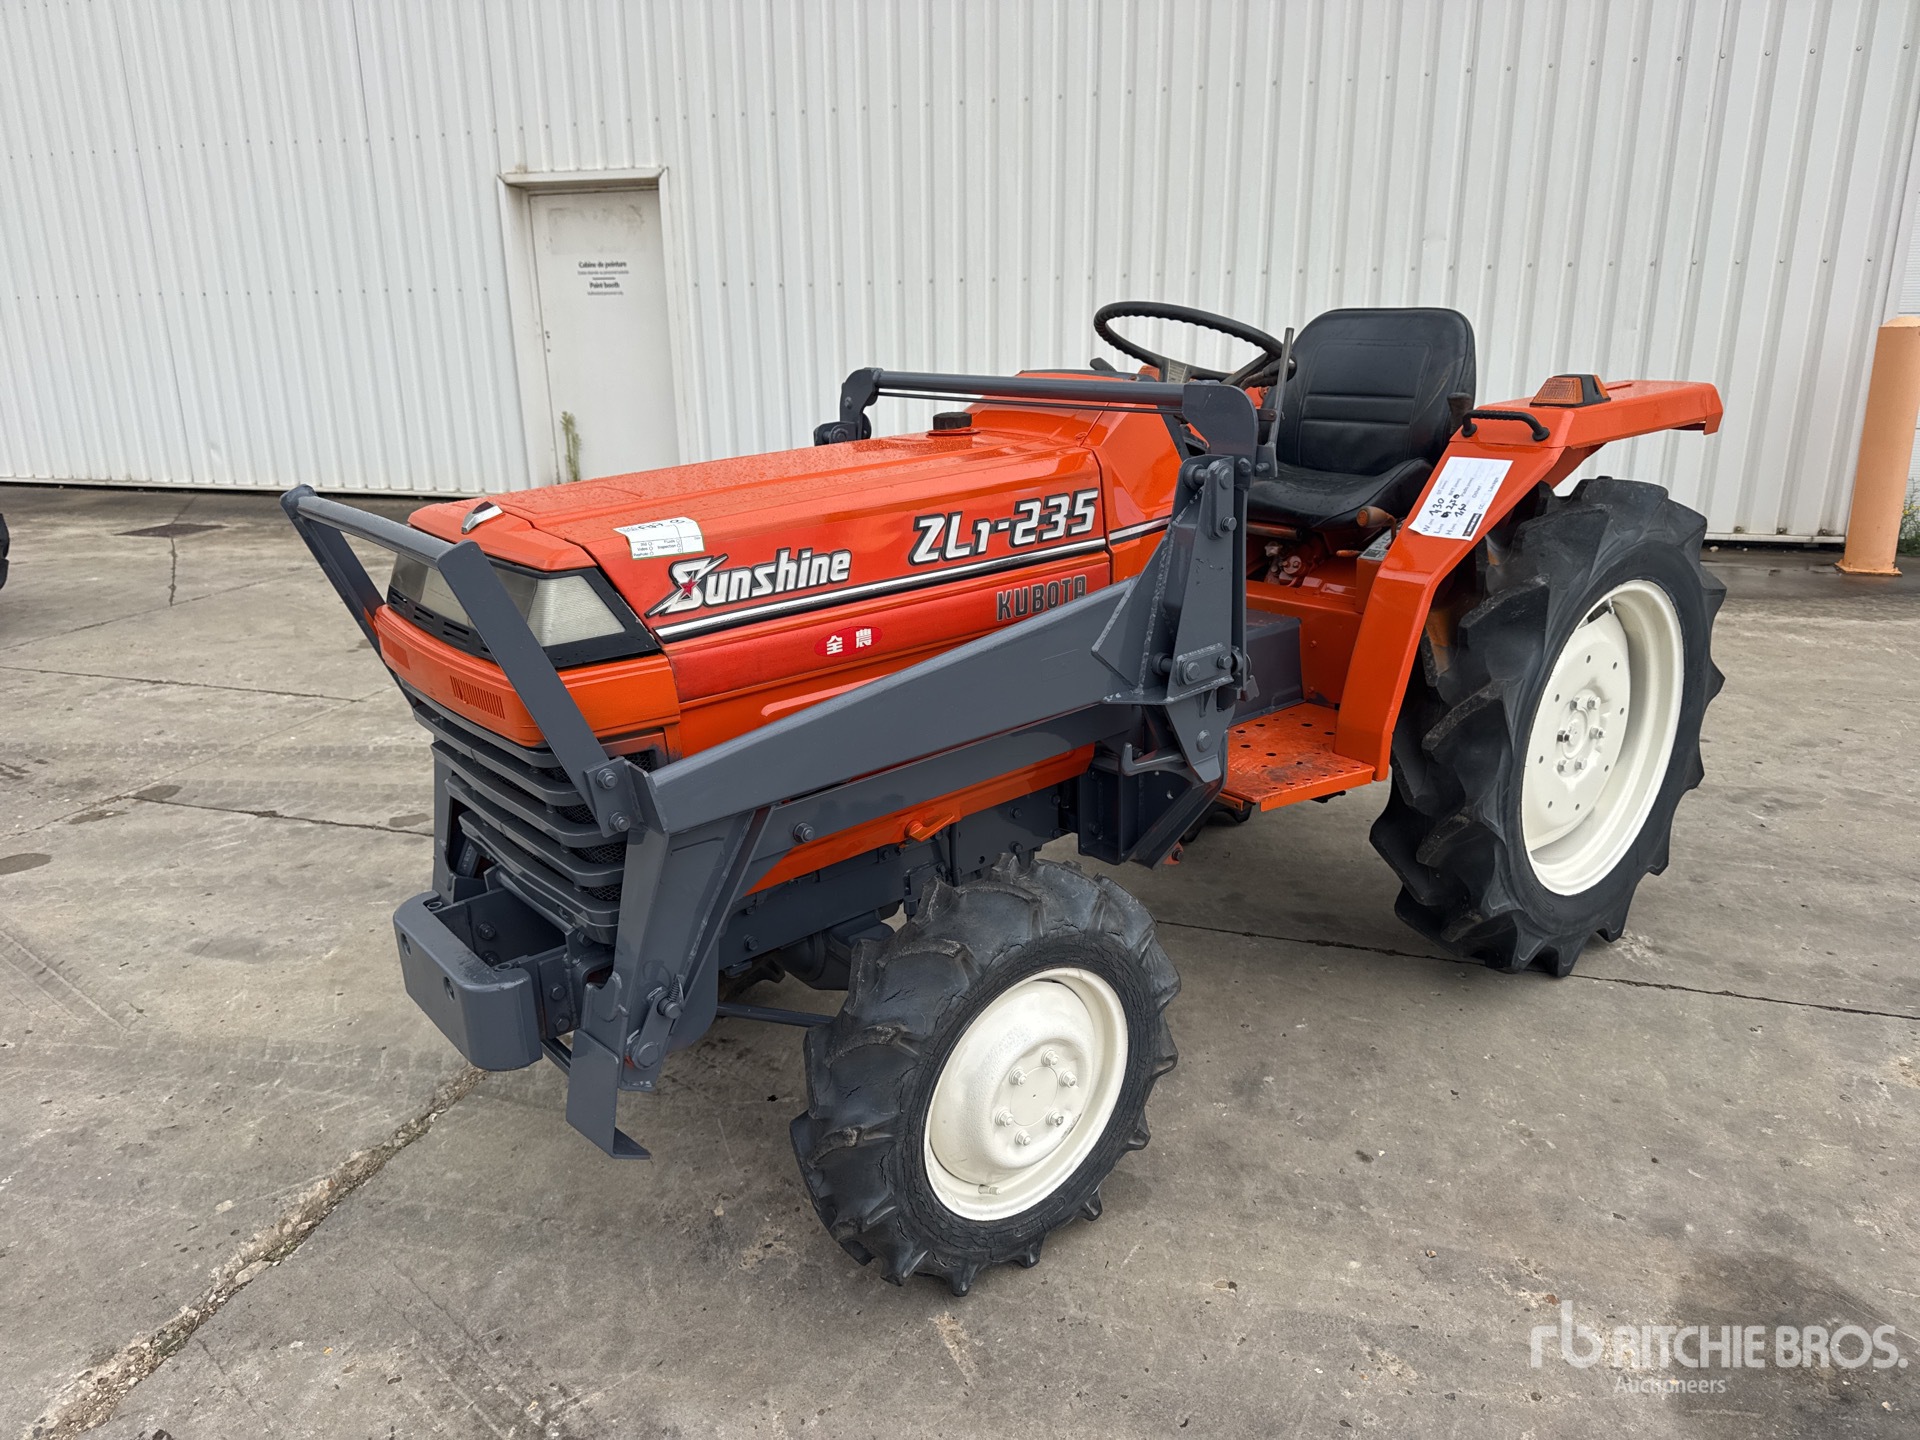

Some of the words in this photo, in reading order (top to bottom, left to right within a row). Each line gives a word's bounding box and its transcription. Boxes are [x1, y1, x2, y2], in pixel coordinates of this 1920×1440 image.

[605, 261, 627, 269] peinture
[603, 281, 620, 289] booth
[643, 548, 852, 618] Sunshine
[996, 574, 1087, 621] KUBOTA
